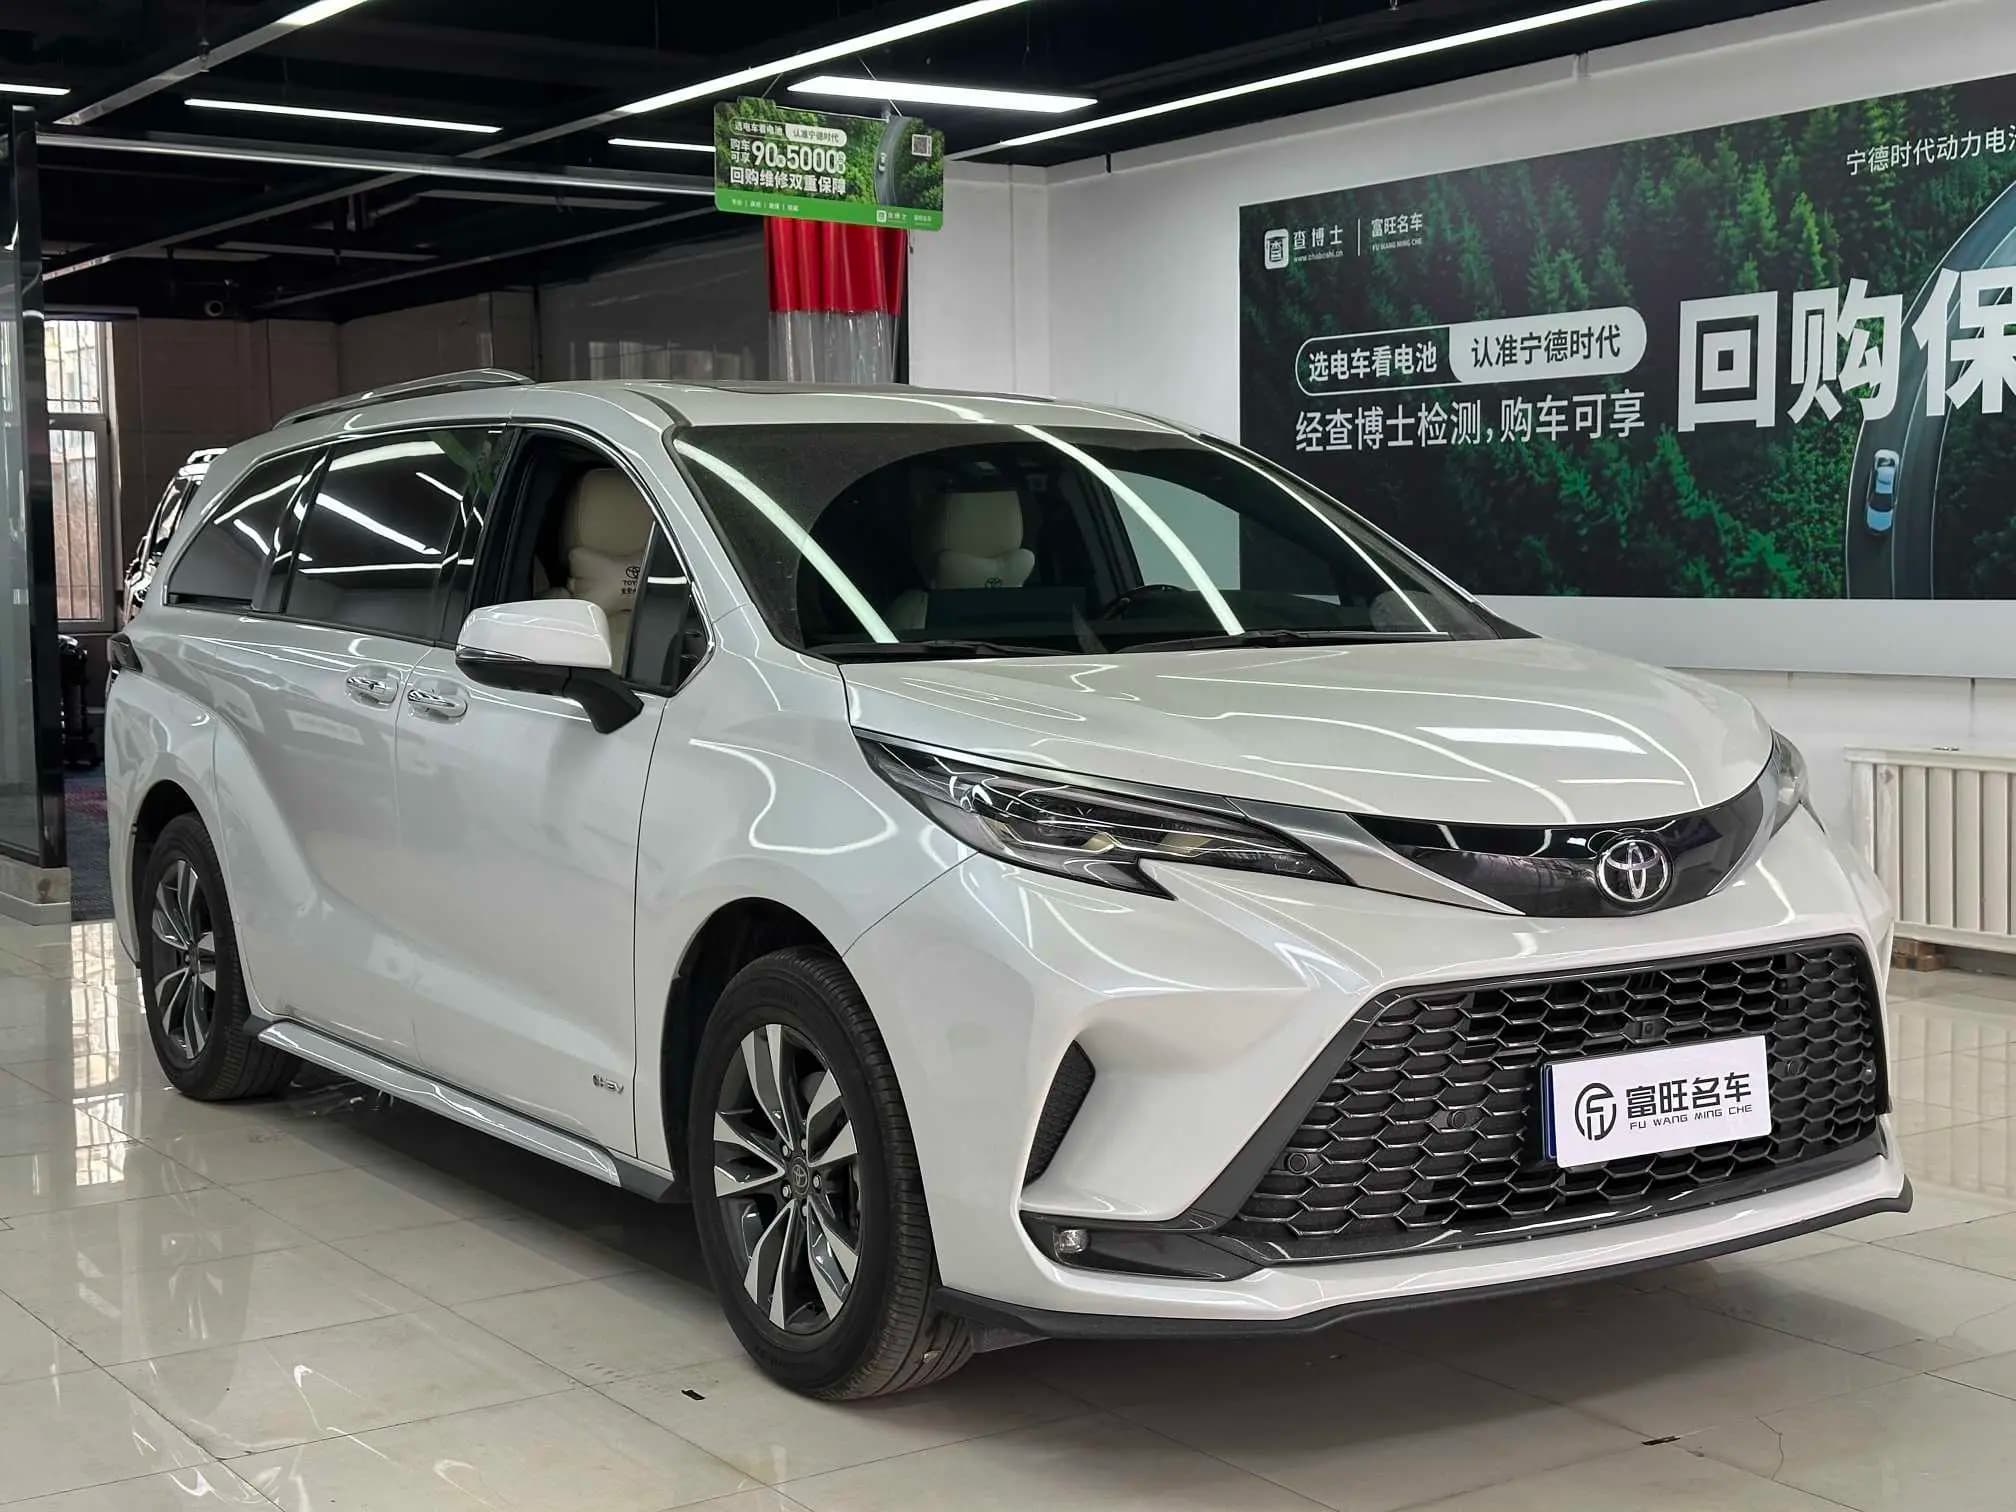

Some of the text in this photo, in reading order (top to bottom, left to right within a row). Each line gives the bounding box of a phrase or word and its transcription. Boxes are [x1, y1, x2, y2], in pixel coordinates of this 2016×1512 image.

[730, 166, 847, 195] 回购维修双重保障
[1292, 224, 1344, 250] 查博士
[1371, 212, 1423, 238] 富旺名车
[1308, 341, 1438, 383] 选电车看电池
[1471, 324, 1621, 369] 认准宁德时代
[1677, 265, 2016, 433] 回购保
[1625, 1072, 1752, 1119] 富旺名车
[1629, 1104, 1753, 1130] FU WANG MING CHE
